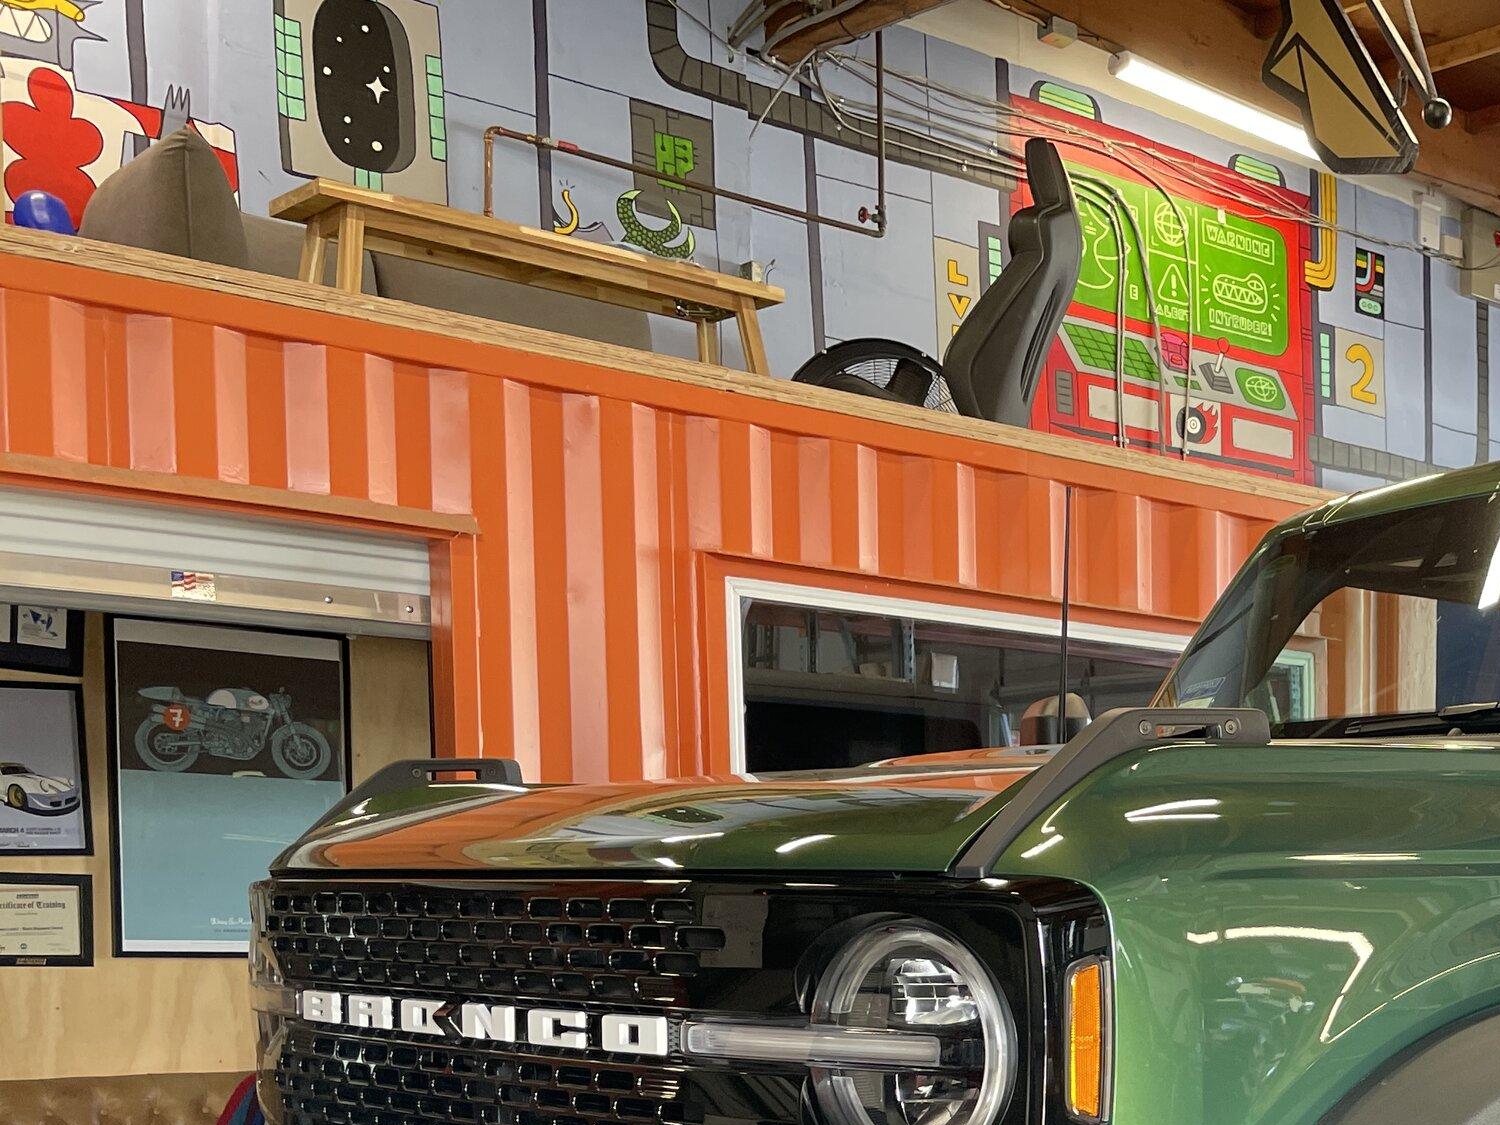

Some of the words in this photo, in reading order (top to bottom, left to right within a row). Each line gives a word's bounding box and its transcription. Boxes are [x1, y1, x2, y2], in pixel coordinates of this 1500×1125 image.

[1206, 225, 1270, 258] WARNING
[947, 259, 971, 338] LV
[1209, 308, 1272, 337] INTRUDER!
[1345, 343, 1377, 405] 2
[169, 708, 183, 728] 7
[302, 989, 669, 1057] BRONCO
